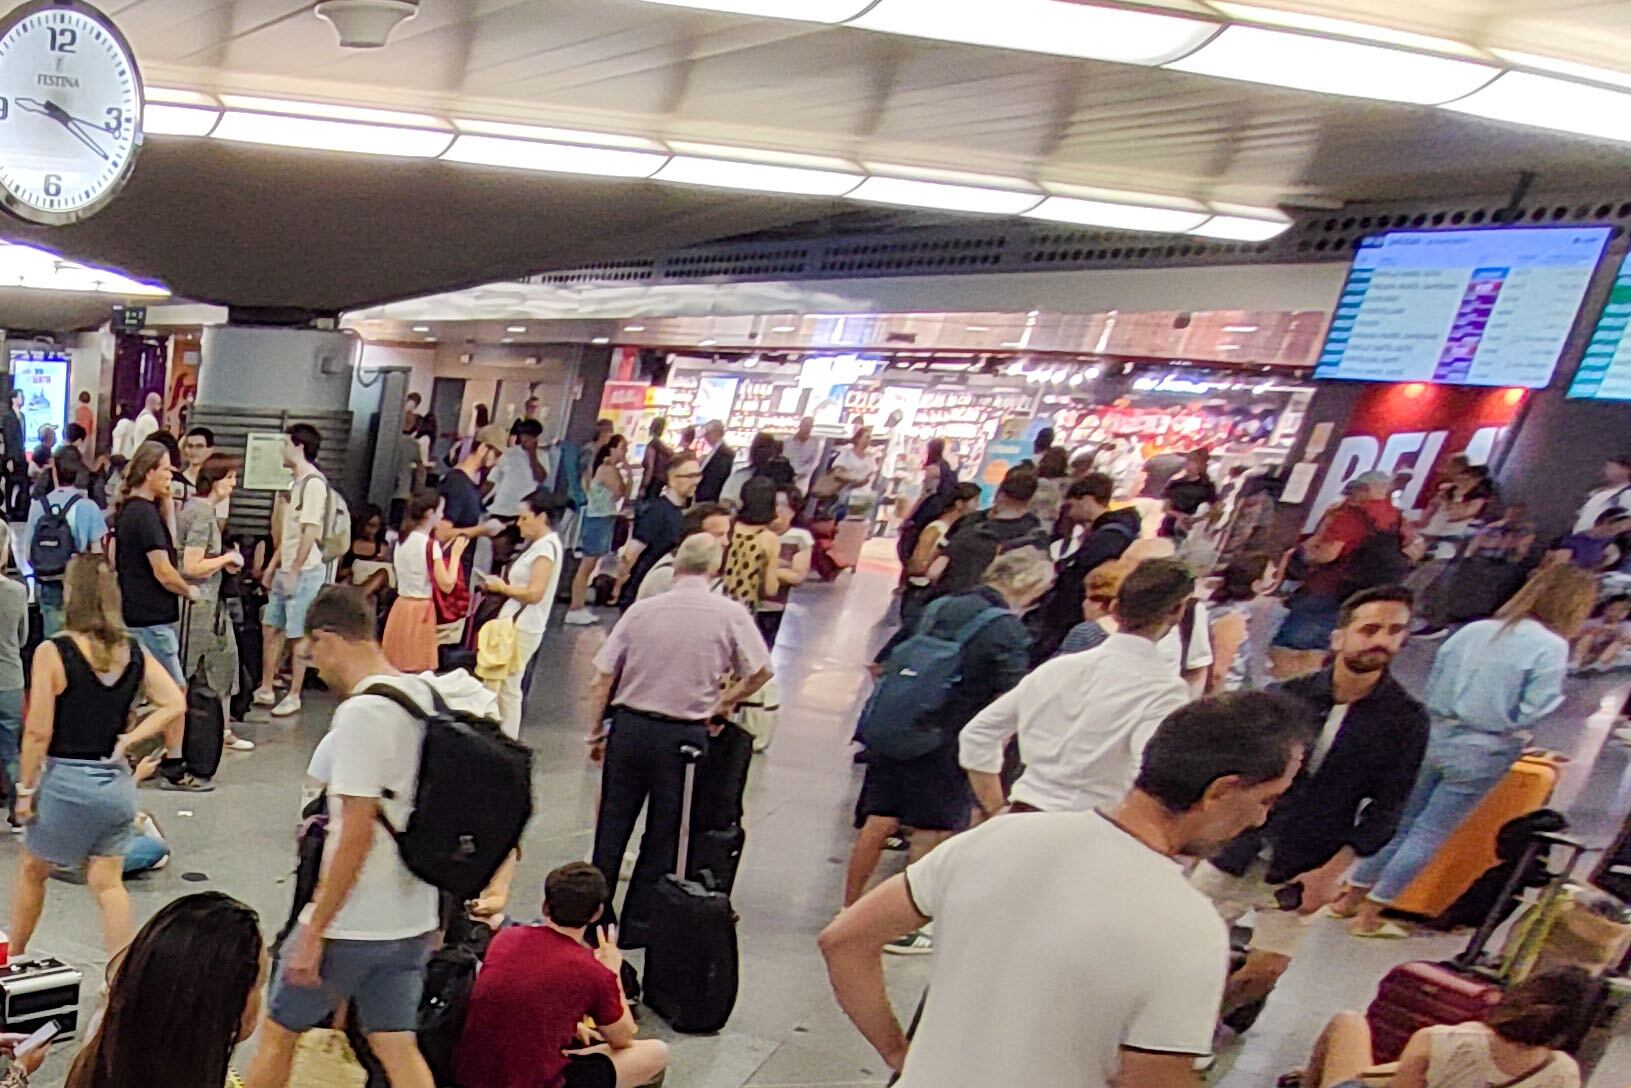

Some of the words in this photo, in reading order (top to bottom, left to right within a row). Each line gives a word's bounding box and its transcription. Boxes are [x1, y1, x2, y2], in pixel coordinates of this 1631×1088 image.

[46, 26, 76, 54] 12
[37, 73, 80, 89] FESTINA
[105, 107, 123, 132] 3
[43, 174, 62, 197] 6
